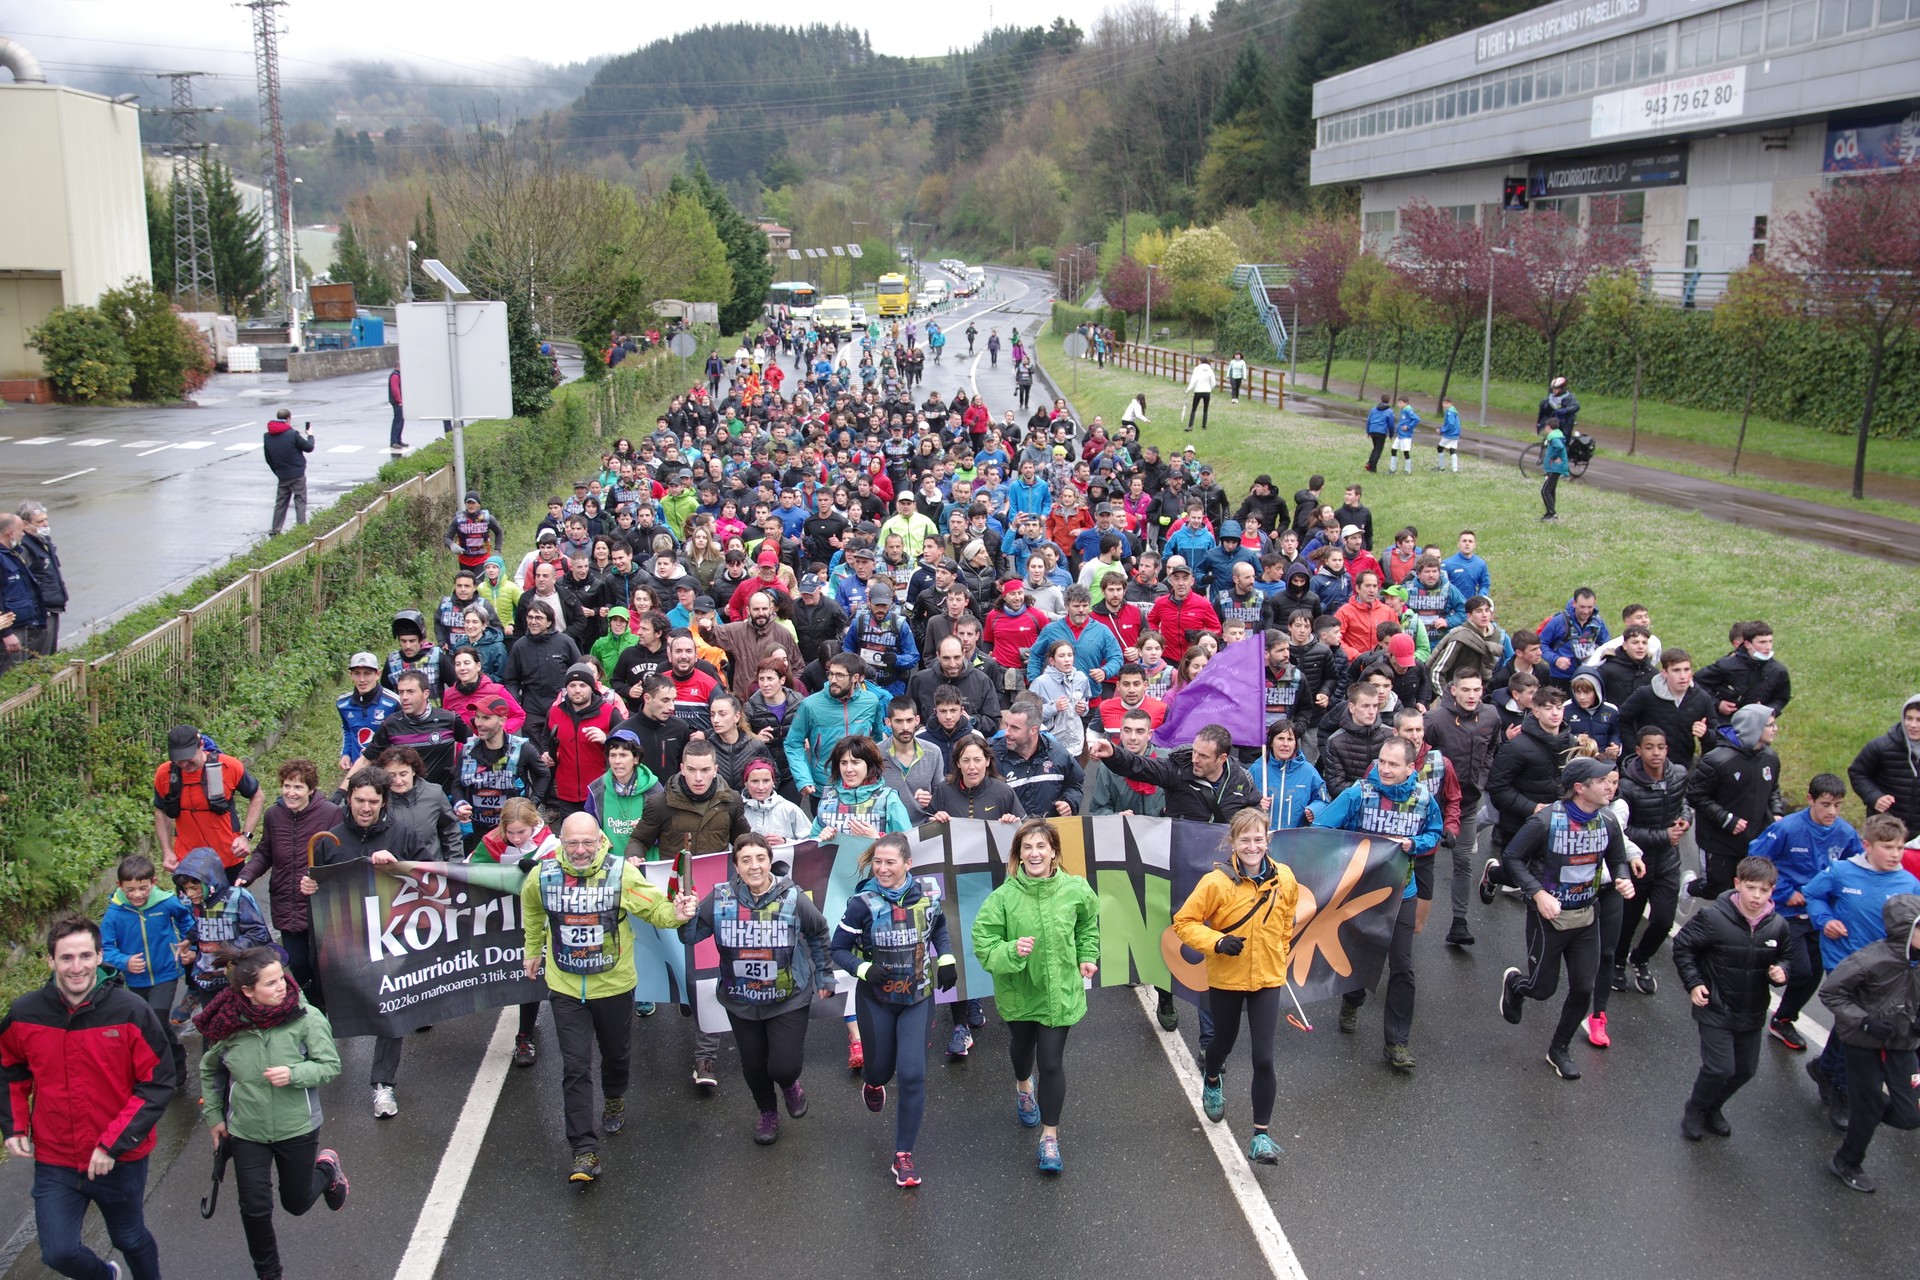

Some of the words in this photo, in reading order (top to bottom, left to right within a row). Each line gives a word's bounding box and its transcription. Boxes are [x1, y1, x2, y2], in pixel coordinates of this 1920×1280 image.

[1478, 38, 1486, 61] EN
[1487, 30, 1506, 57] VENTA
[1516, 22, 1544, 48] NUEVAS
[1543, 10, 1578, 39] OFICINAS
[1579, 9, 1585, 28] Y
[1586, 0, 1640, 26] PABELLONES
[1706, 70, 1735, 85] OFICINAS
[1645, 97, 1667, 117] 943
[1673, 93, 1688, 112] 79
[1692, 89, 1709, 109] 62
[1714, 84, 1733, 105] 80
[481, 796, 500, 807] 232
[571, 927, 595, 944] 251
[379, 949, 480, 995] Amurriotik
[745, 963, 769, 978] 251
[379, 993, 420, 1014] 2022ko
[421, 977, 479, 1001] martxoaren
[480, 968, 507, 984] 31tik
[883, 976, 913, 994] aek
